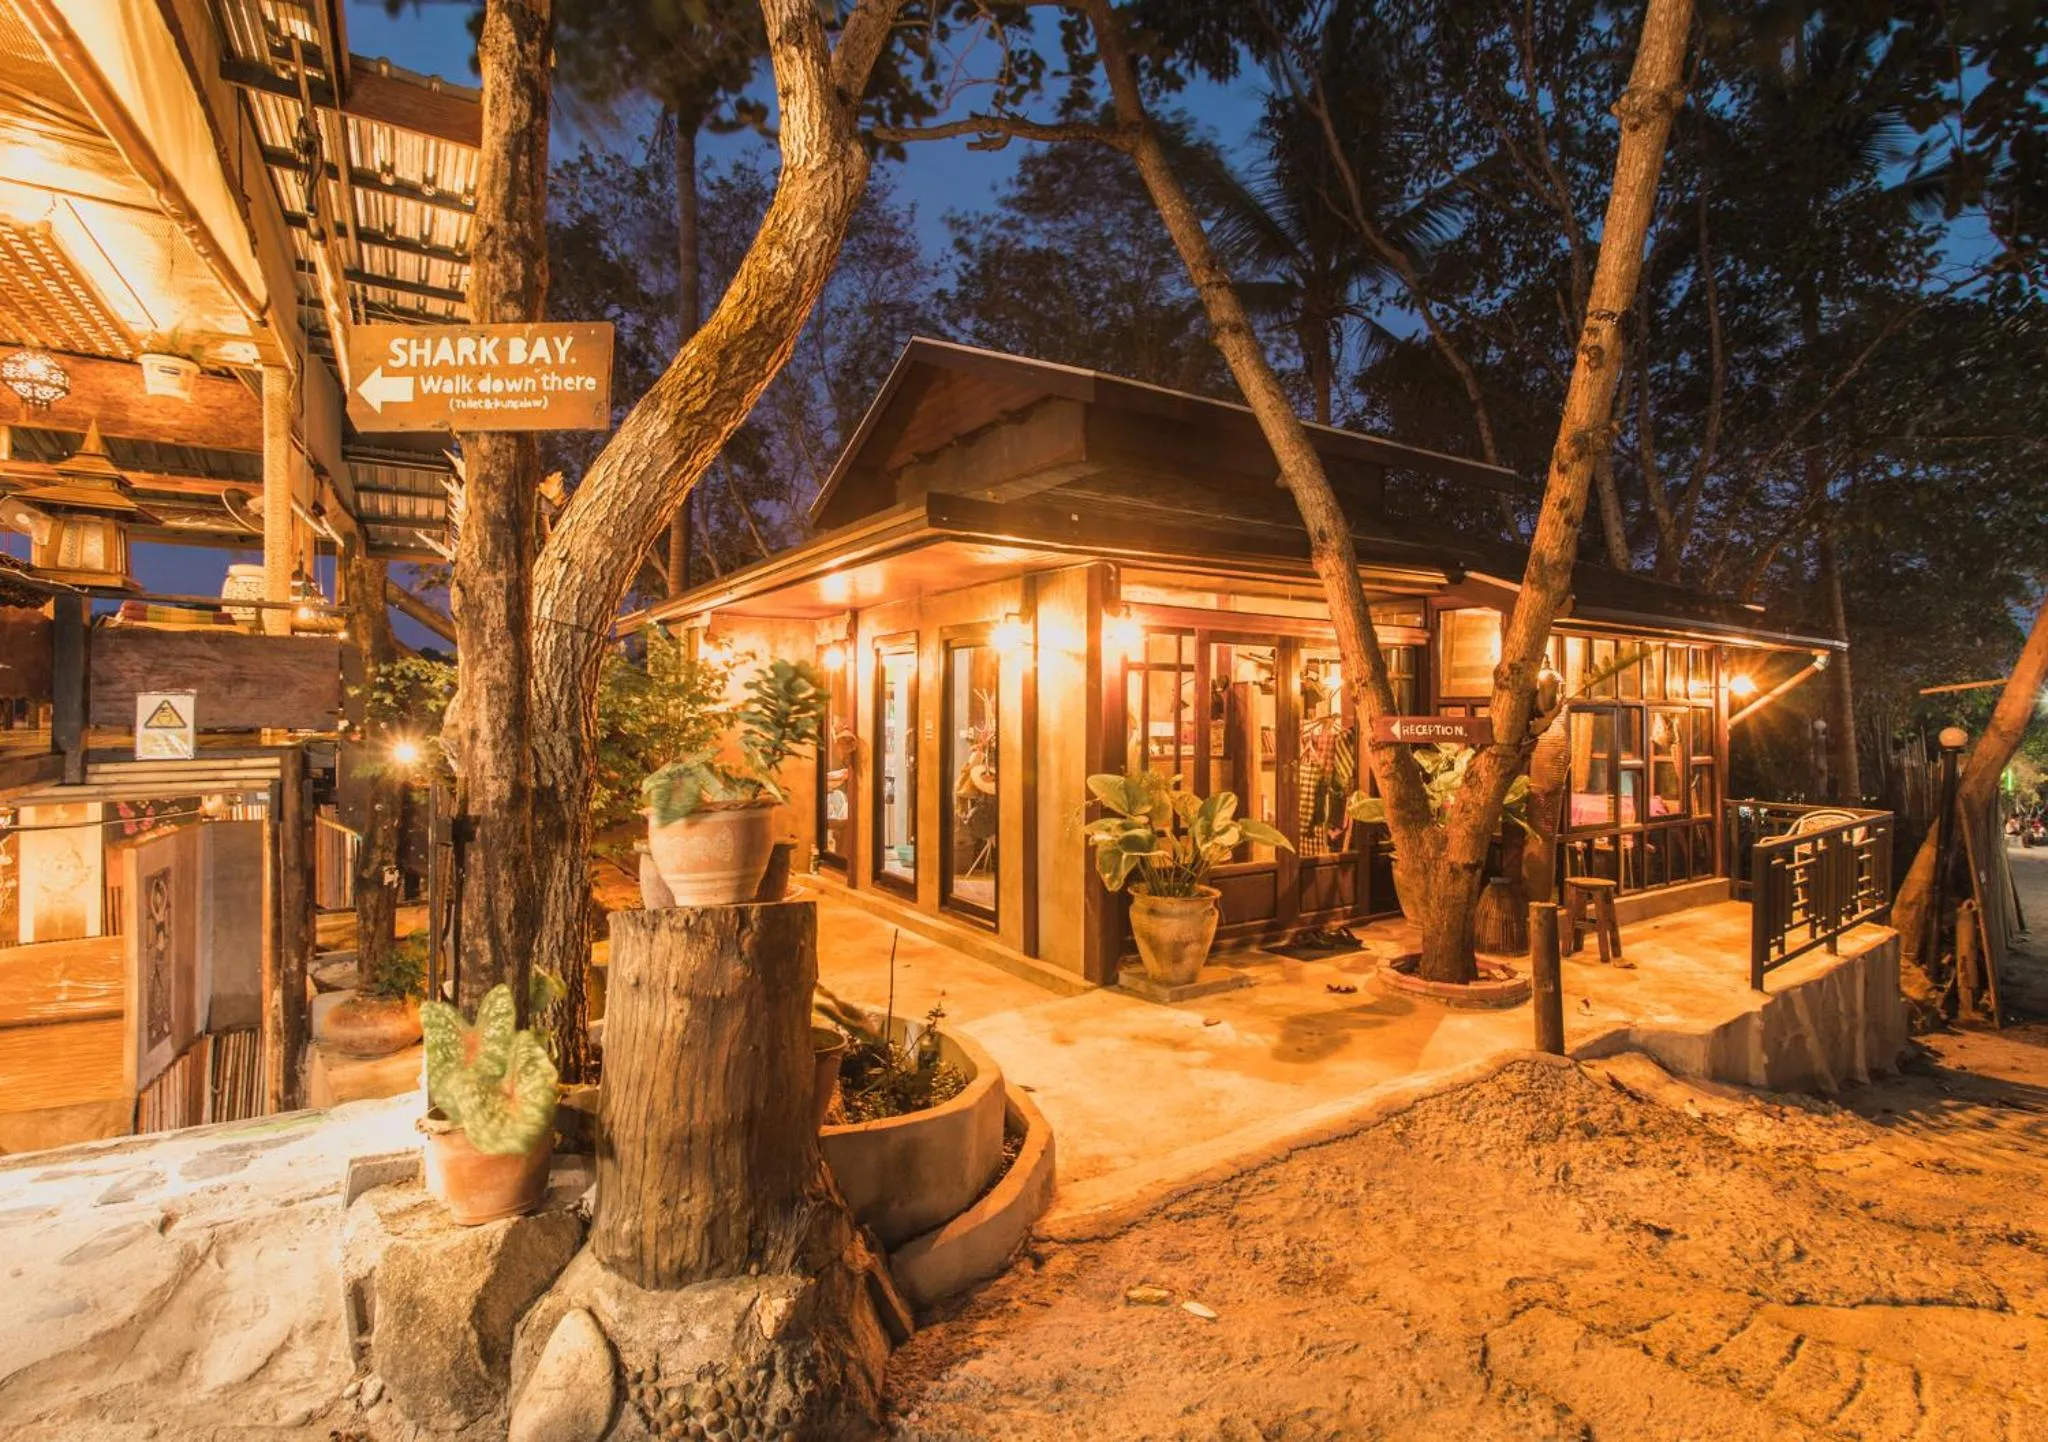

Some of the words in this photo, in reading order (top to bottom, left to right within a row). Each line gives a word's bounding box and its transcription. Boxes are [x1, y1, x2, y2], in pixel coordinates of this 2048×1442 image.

[388, 336, 499, 367] SHARK
[508, 336, 577, 364] BAY.
[420, 374, 472, 394] Walk
[477, 373, 536, 393] down
[541, 371, 596, 391] there
[1402, 725, 1468, 736] RECEPTION.
